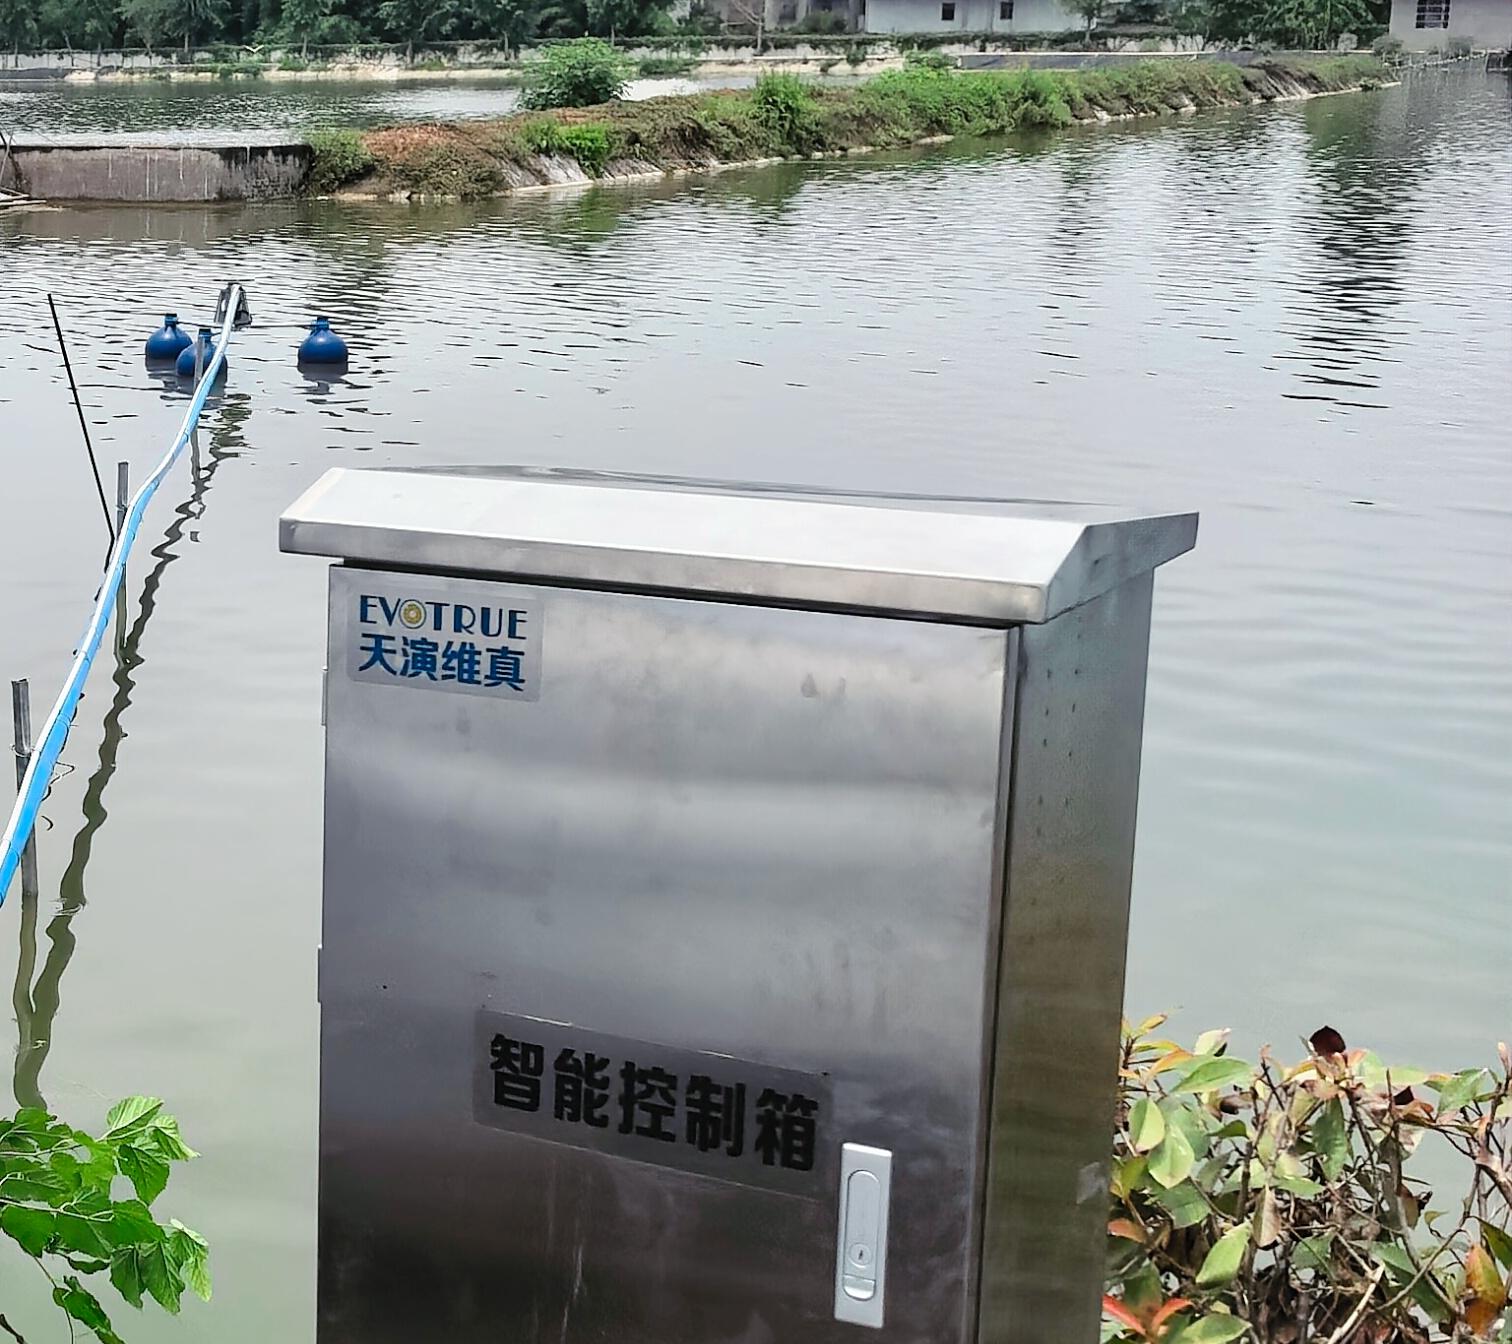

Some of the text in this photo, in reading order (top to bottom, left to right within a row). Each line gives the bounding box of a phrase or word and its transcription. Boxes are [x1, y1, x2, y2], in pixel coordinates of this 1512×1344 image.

[359, 594, 528, 640] EVOTRUE
[358, 632, 526, 692] 天演维真
[490, 1033, 819, 1171] 智能控制箱
